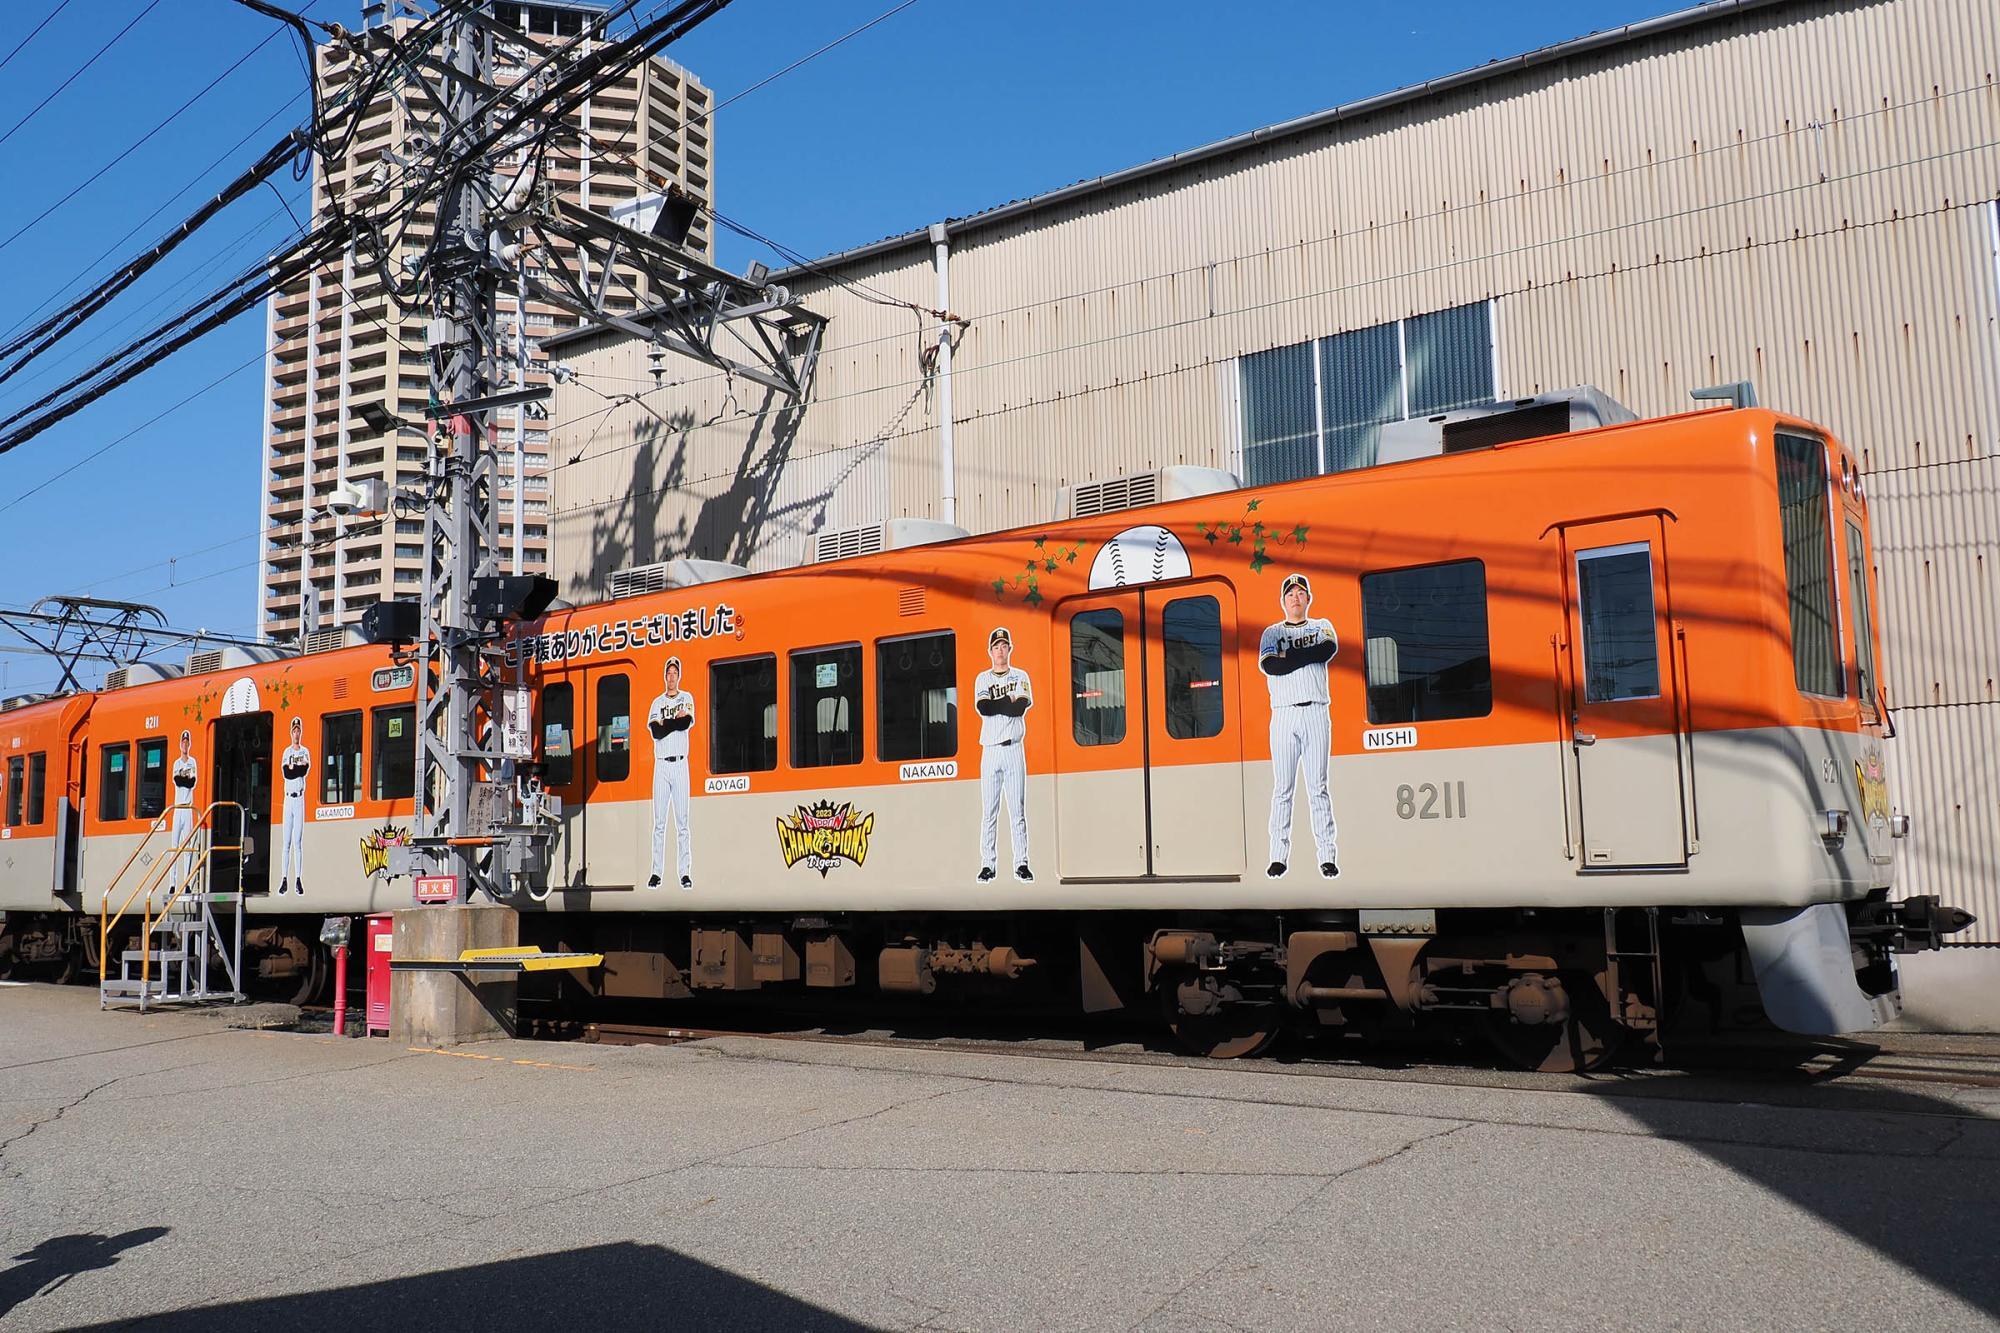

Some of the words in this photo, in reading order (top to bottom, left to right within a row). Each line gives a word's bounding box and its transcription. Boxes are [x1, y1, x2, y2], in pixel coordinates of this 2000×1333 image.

[145, 716, 159, 729] 8211
[1368, 730, 1412, 747] NISHI
[902, 763, 955, 779] NAKANO
[708, 778, 746, 791] AOYAGI
[1396, 781, 1467, 819] 8211
[317, 807, 353, 818] SAKAMOTO
[801, 809, 846, 831] NIPPON
[815, 809, 832, 818] 2023
[777, 812, 874, 869] CHAMPIONS
[807, 855, 841, 870] Tigers
[420, 882, 451, 894] 消火栓
